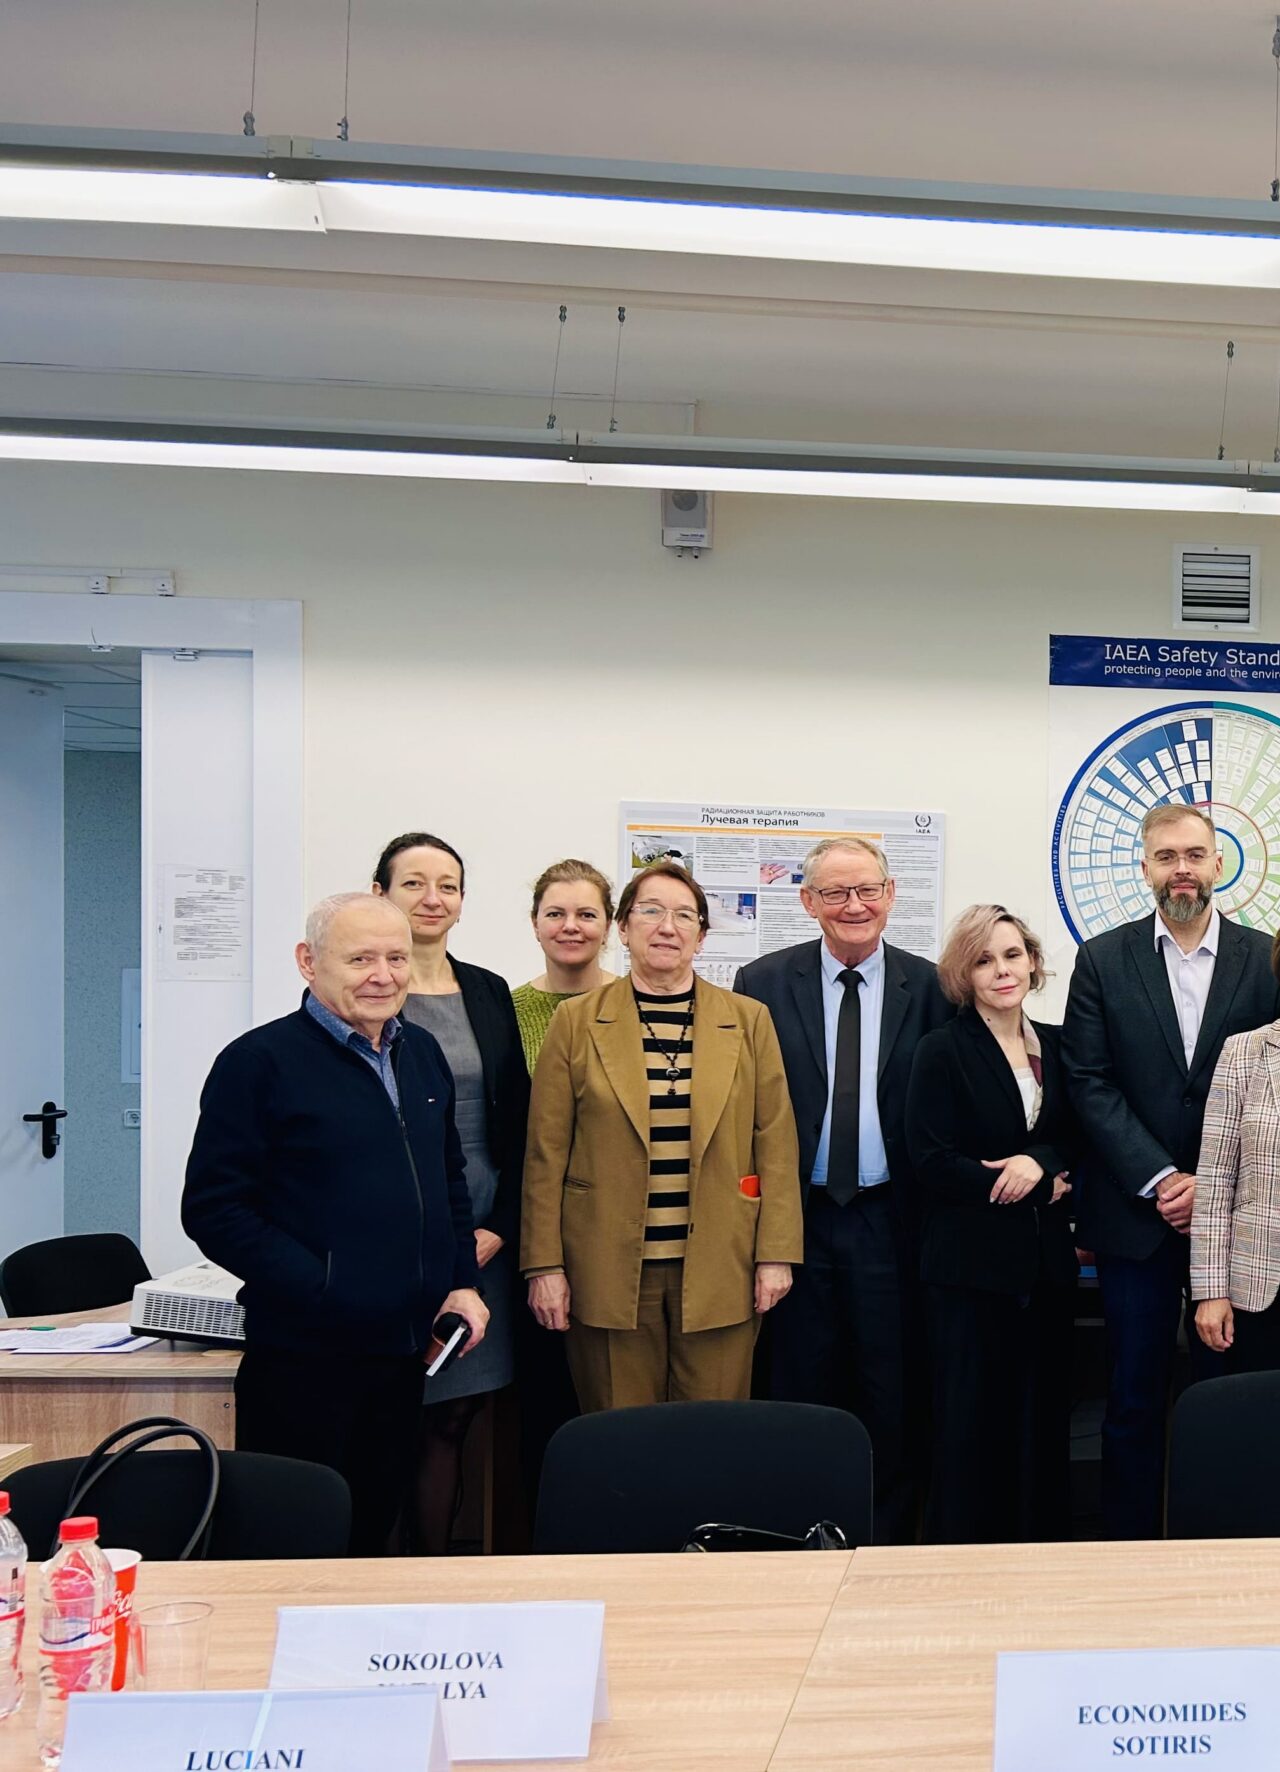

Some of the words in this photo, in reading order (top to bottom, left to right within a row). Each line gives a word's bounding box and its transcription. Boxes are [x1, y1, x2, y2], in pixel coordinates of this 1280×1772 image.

[1104, 644, 1151, 661] IAEA
[1158, 646, 1218, 667] Safety
[1104, 664, 1161, 677] protecting
[1165, 666, 1202, 678] people
[1205, 667, 1226, 677] and
[1230, 668, 1248, 678] the
[701, 807, 754, 815] РАДИАЦИОННАЯ
[756, 809, 782, 817] ЗАЩИТА
[783, 810, 826, 818] РАБОТНИКОВ
[701, 814, 749, 826] Лучевая
[752, 817, 799, 827] терапия
[367, 1651, 505, 1672] SOKOLOVA
[1078, 1702, 1247, 1725] ECONOMIDES
[1112, 1734, 1212, 1756] SOTIRIS
[185, 1748, 306, 1771] LUCIANI
